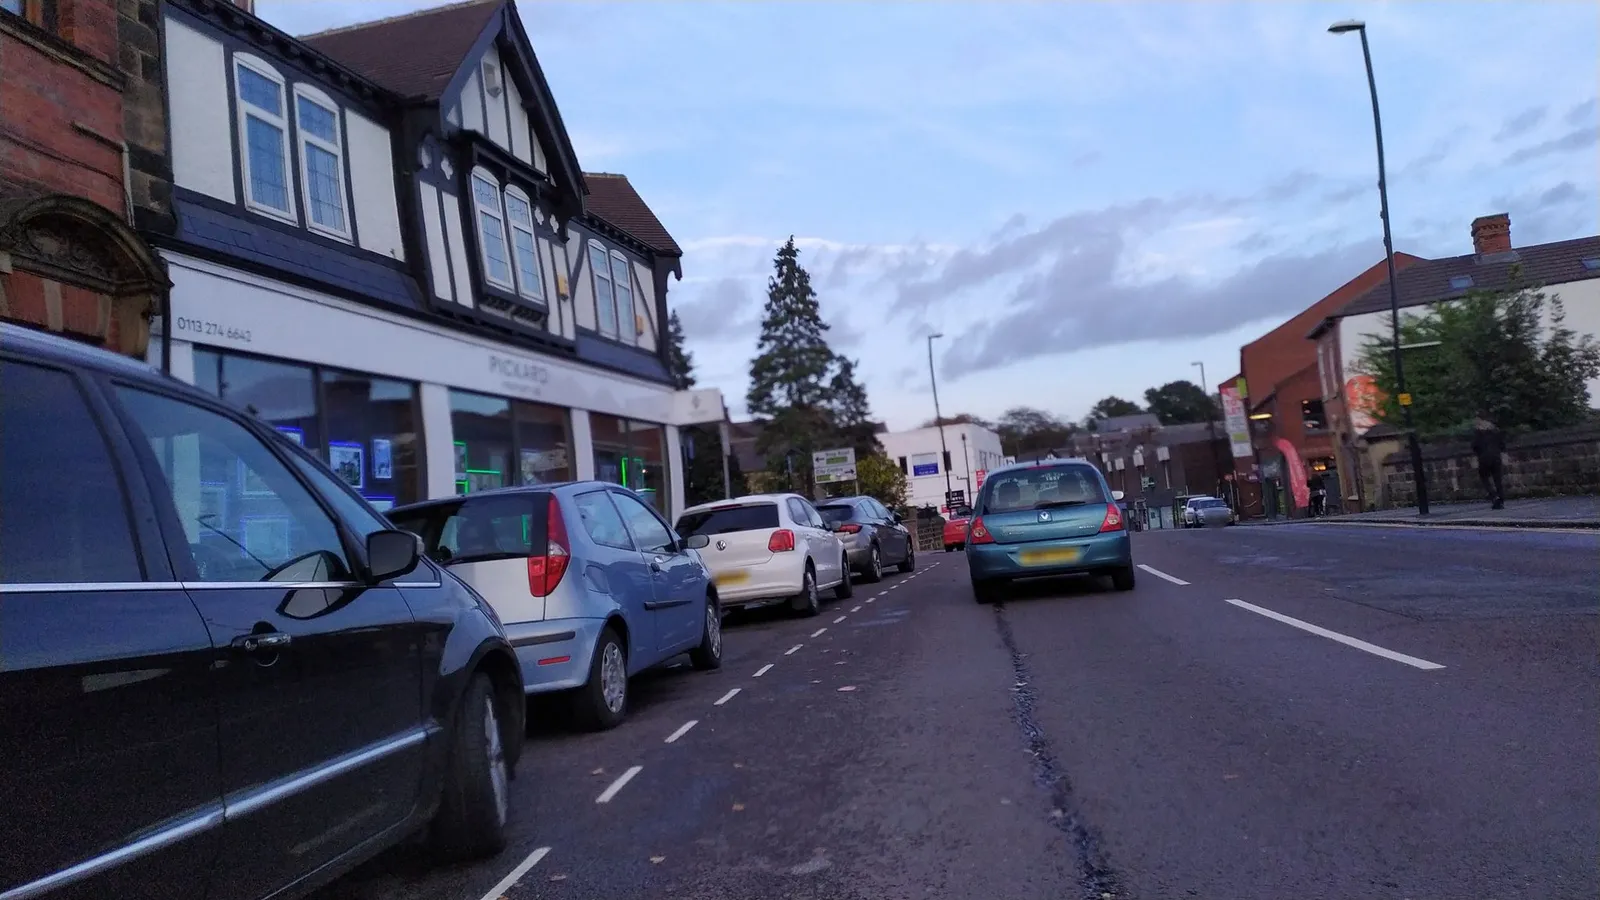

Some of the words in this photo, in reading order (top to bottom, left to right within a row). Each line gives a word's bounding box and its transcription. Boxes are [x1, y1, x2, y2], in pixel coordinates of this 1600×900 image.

[177, 316, 202, 332] 0113
[205, 322, 225, 336] 274
[226, 326, 252, 342] 6642
[488, 354, 549, 384] PICKARD
